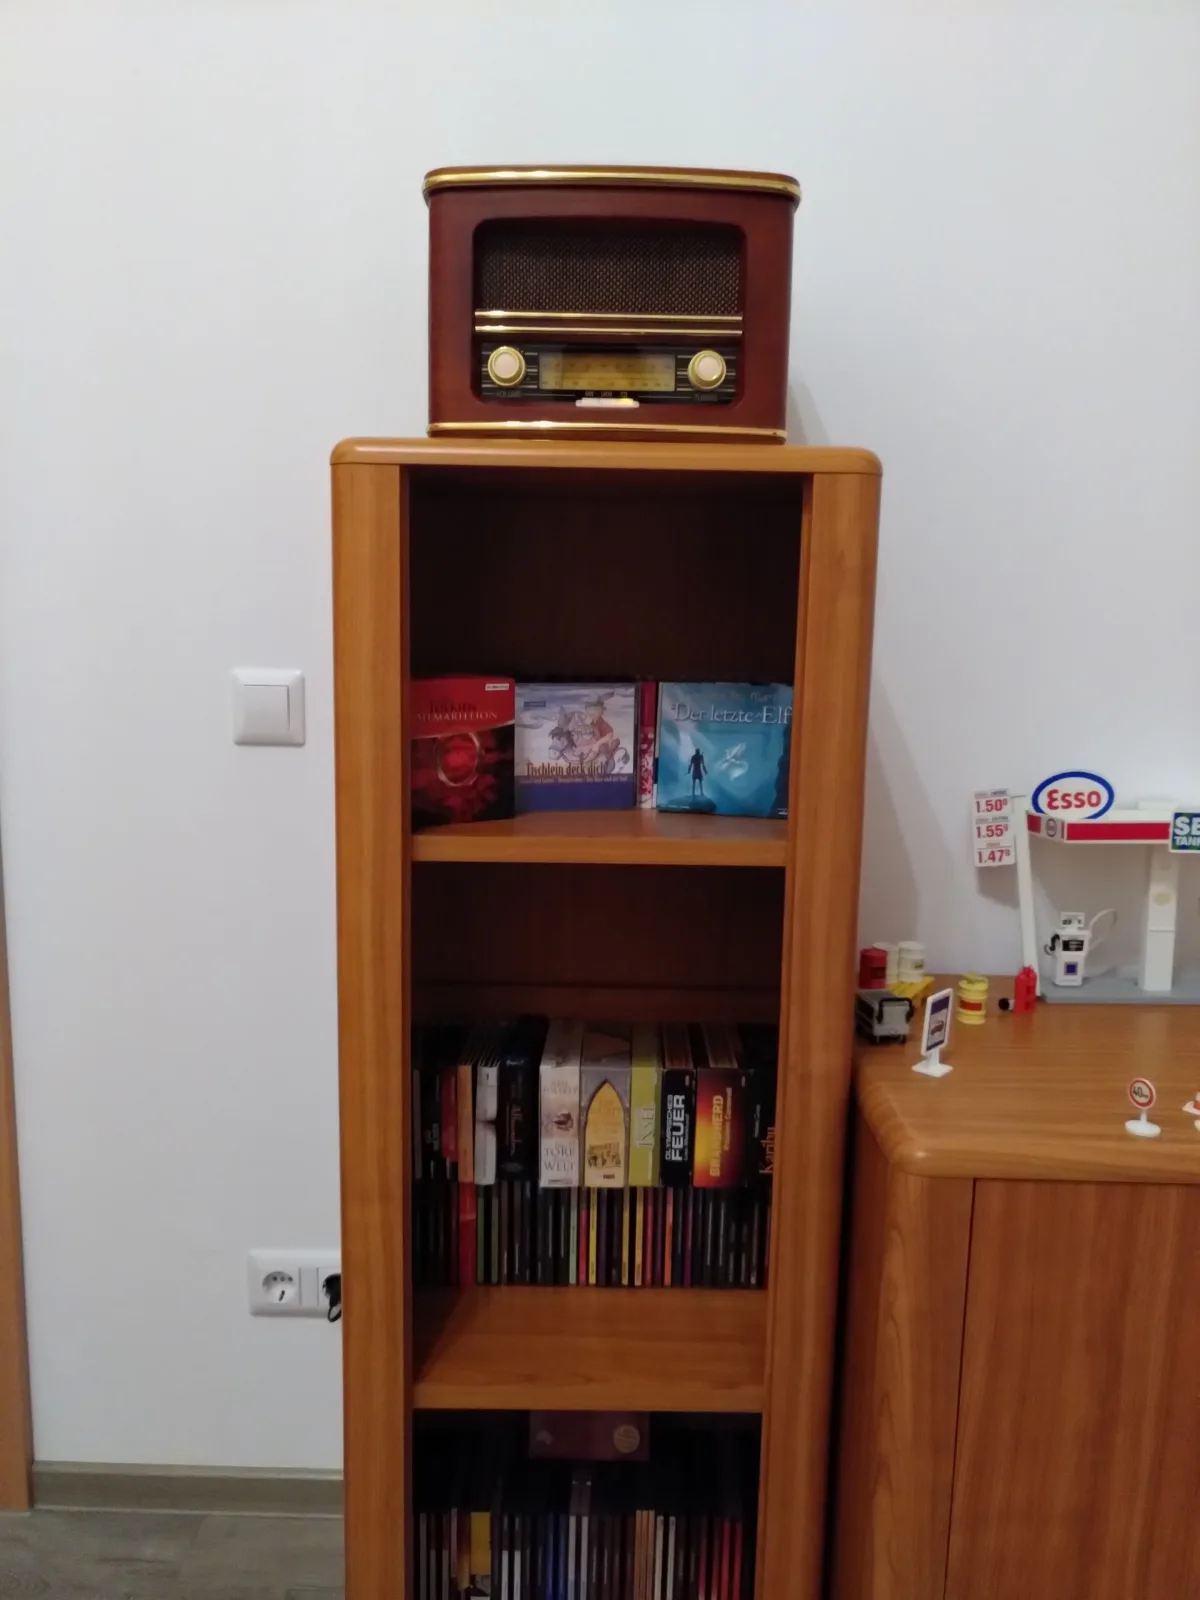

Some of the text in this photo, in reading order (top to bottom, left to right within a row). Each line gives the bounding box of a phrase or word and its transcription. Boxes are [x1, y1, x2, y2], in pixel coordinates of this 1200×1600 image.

[674, 703, 793, 725] Der letzte Elf
[526, 761, 606, 777] Tischlein deck dich
[665, 1094, 673, 1161] OLYMPISCHES
[672, 1094, 686, 1161] FEUER
[709, 1094, 724, 1177] BRANDHERD
